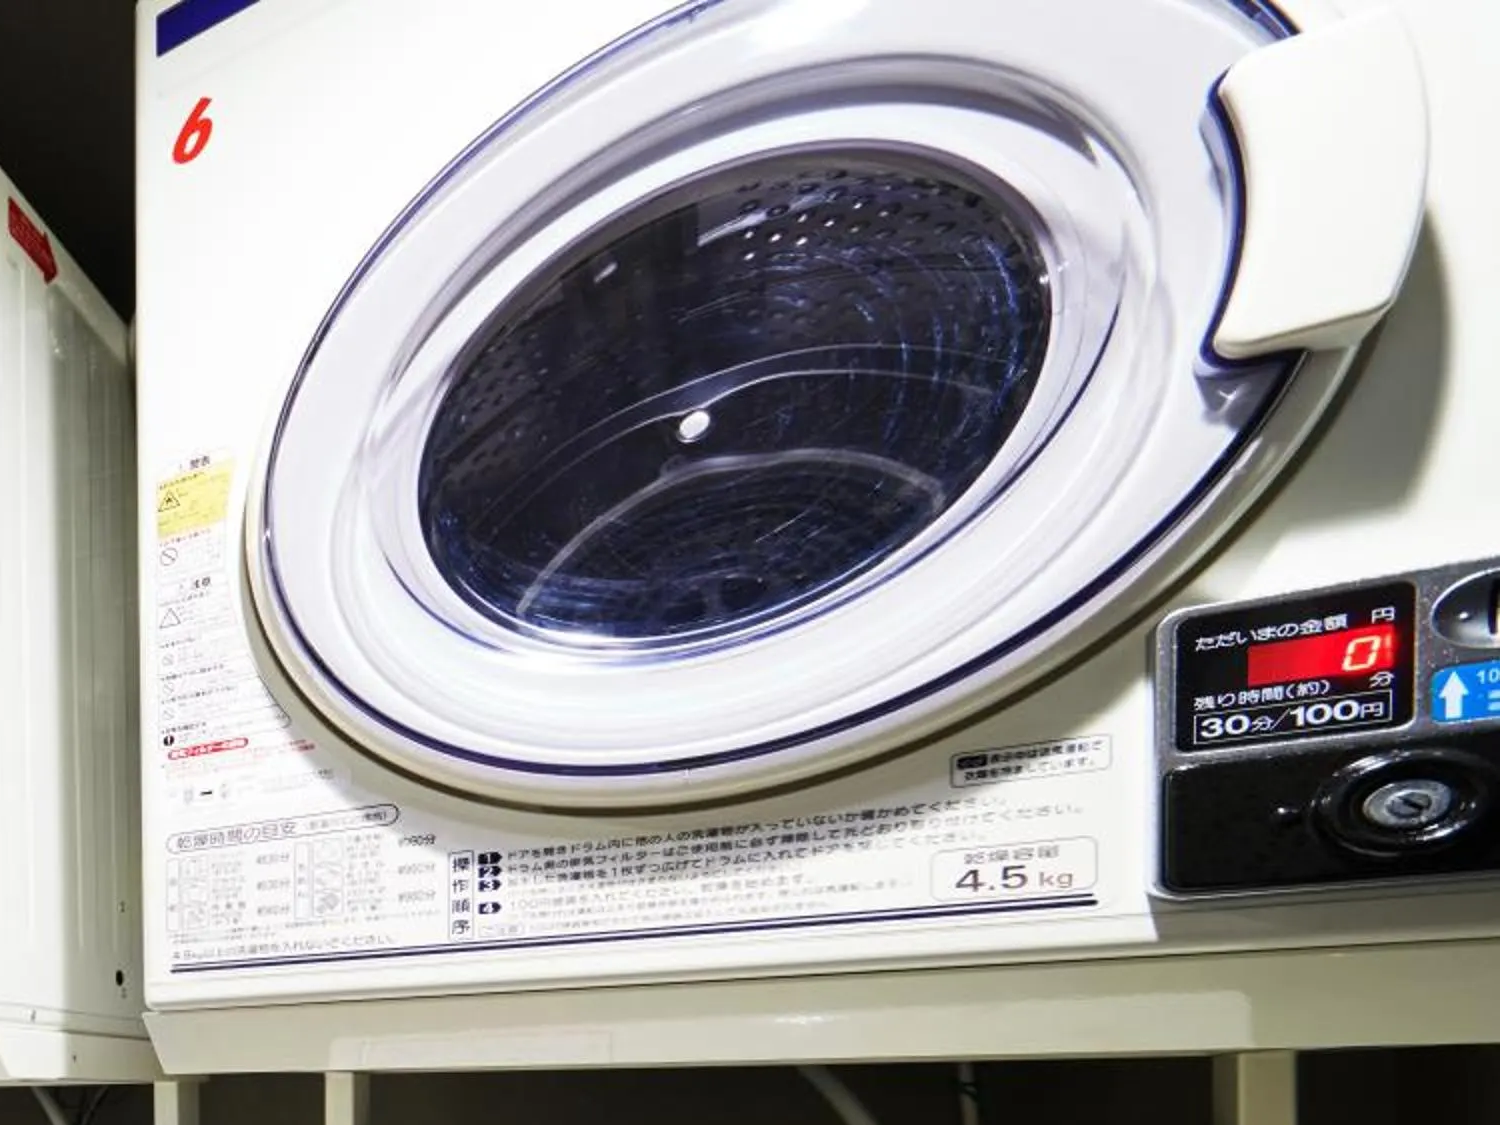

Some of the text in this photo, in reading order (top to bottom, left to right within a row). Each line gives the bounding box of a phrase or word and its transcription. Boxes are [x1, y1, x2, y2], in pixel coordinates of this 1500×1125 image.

[171, 97, 214, 165] 6
[1194, 606, 1395, 652] ただいまの金額 円
[1342, 635, 1381, 672] 0
[1369, 671, 1394, 688] 分
[955, 865, 1074, 893] 4.5 kg
